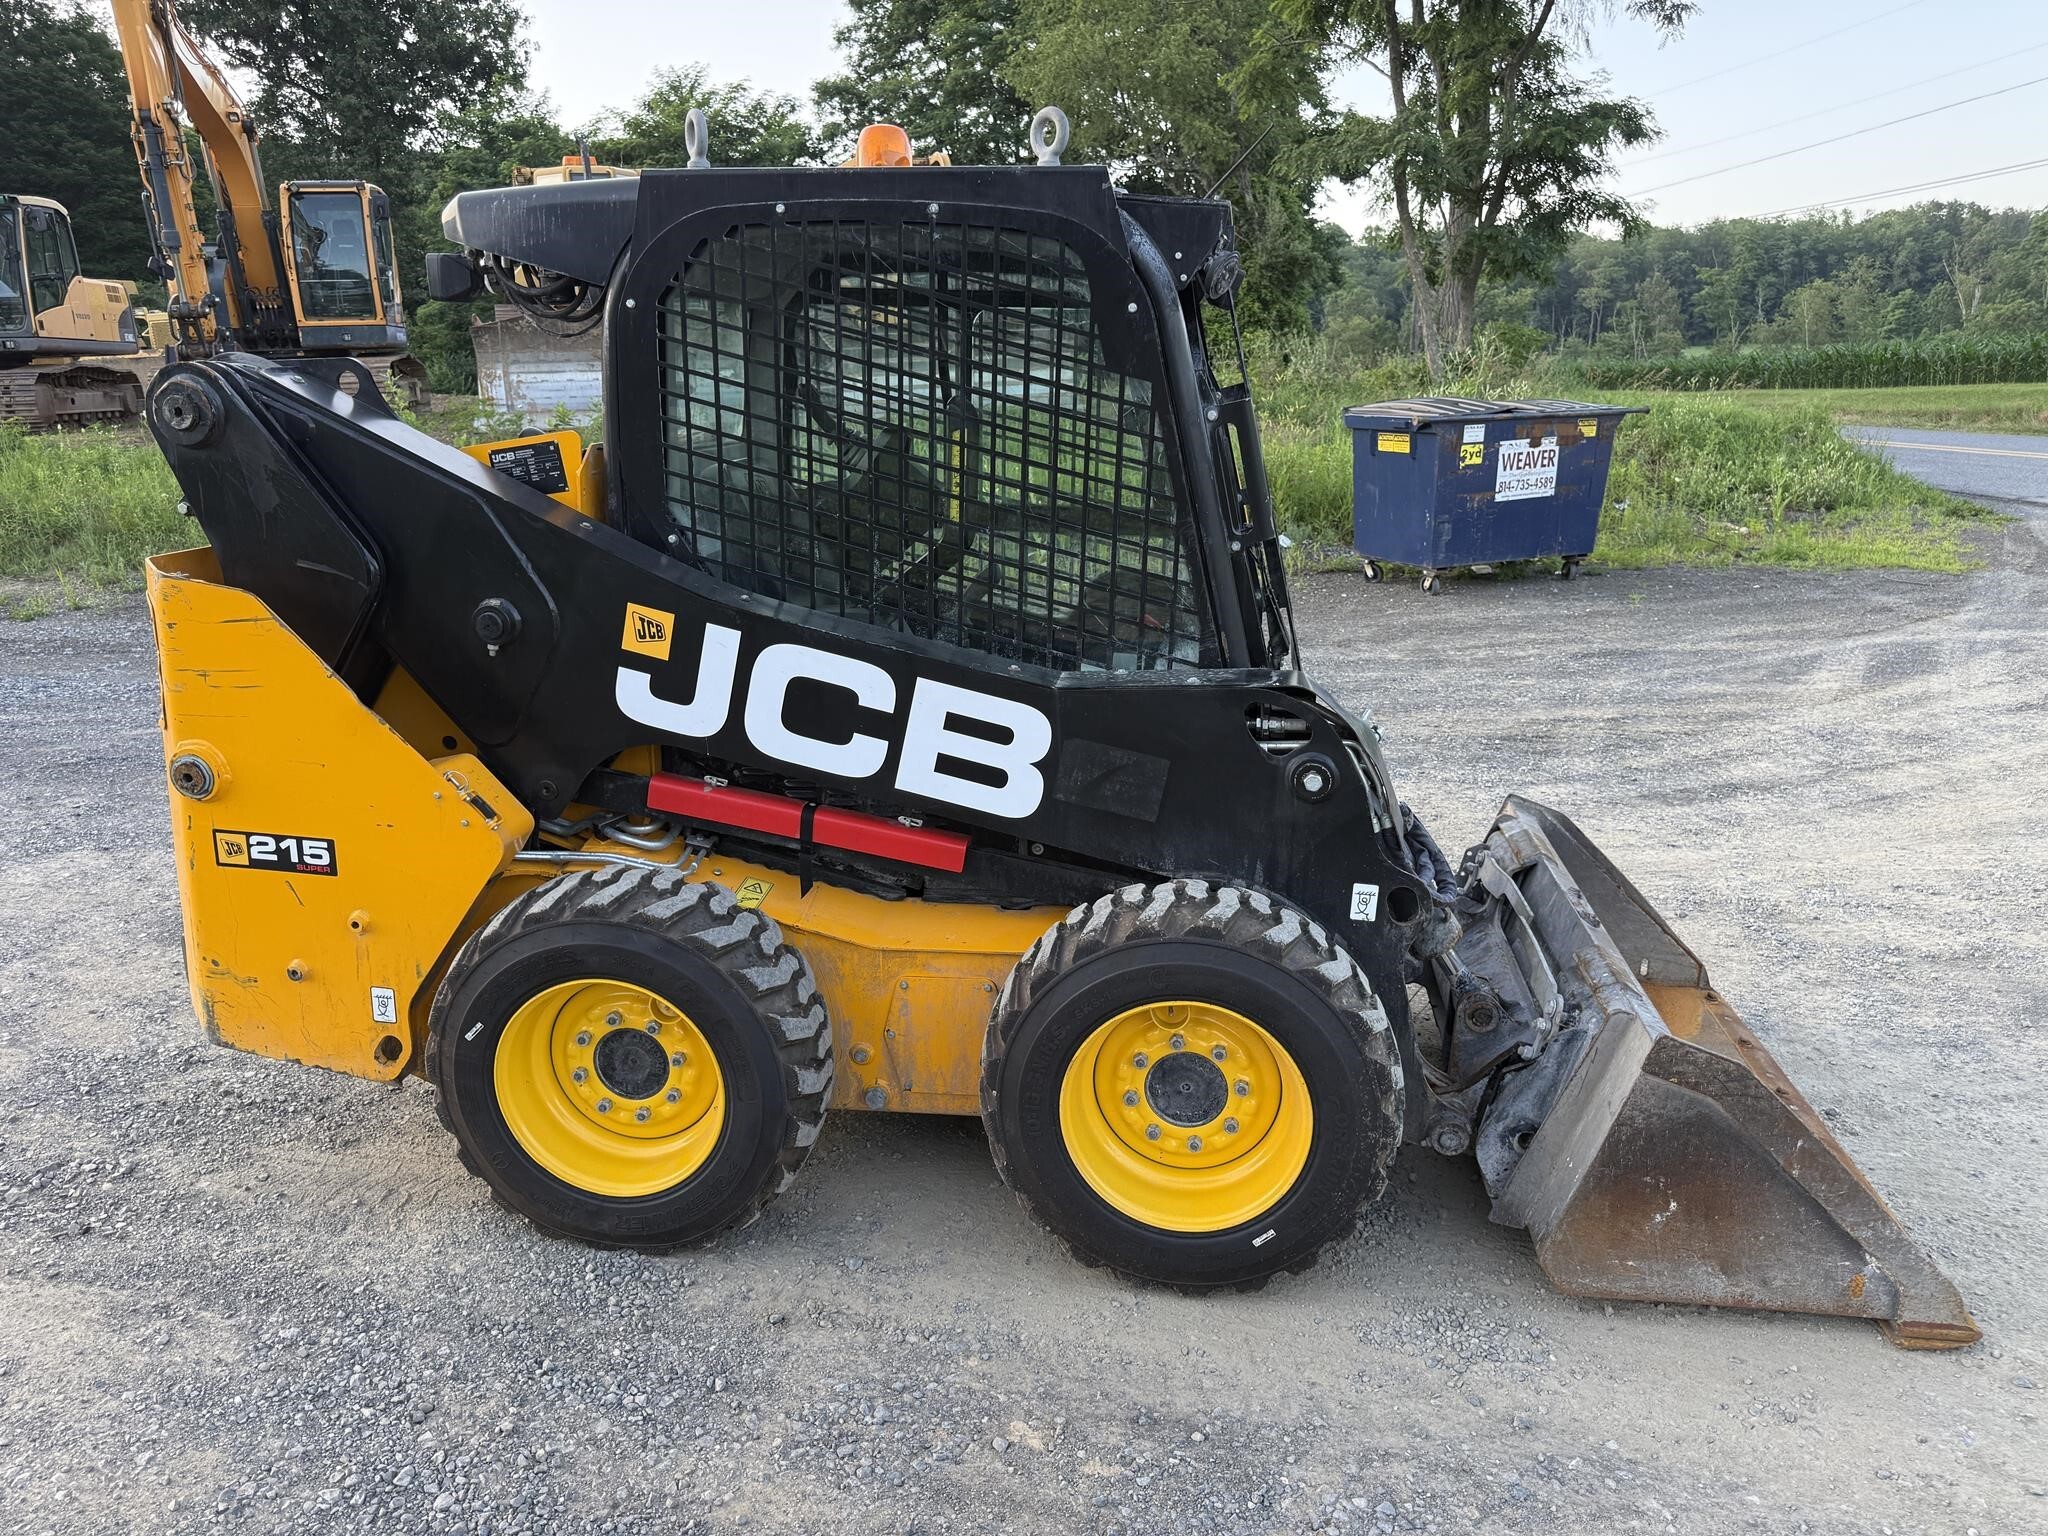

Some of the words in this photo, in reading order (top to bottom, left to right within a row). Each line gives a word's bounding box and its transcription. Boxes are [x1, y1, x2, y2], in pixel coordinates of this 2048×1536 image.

[492, 452, 516, 463] JCB
[1462, 448, 1482, 461] 2yd
[1502, 449, 1556, 472] WEAVER
[1498, 476, 1554, 493] 814-735-4589
[637, 616, 664, 640] JCB
[615, 622, 1052, 819] JCB
[224, 841, 243, 856] JCB
[249, 835, 330, 866] 215
[296, 863, 331, 873] SUPER
